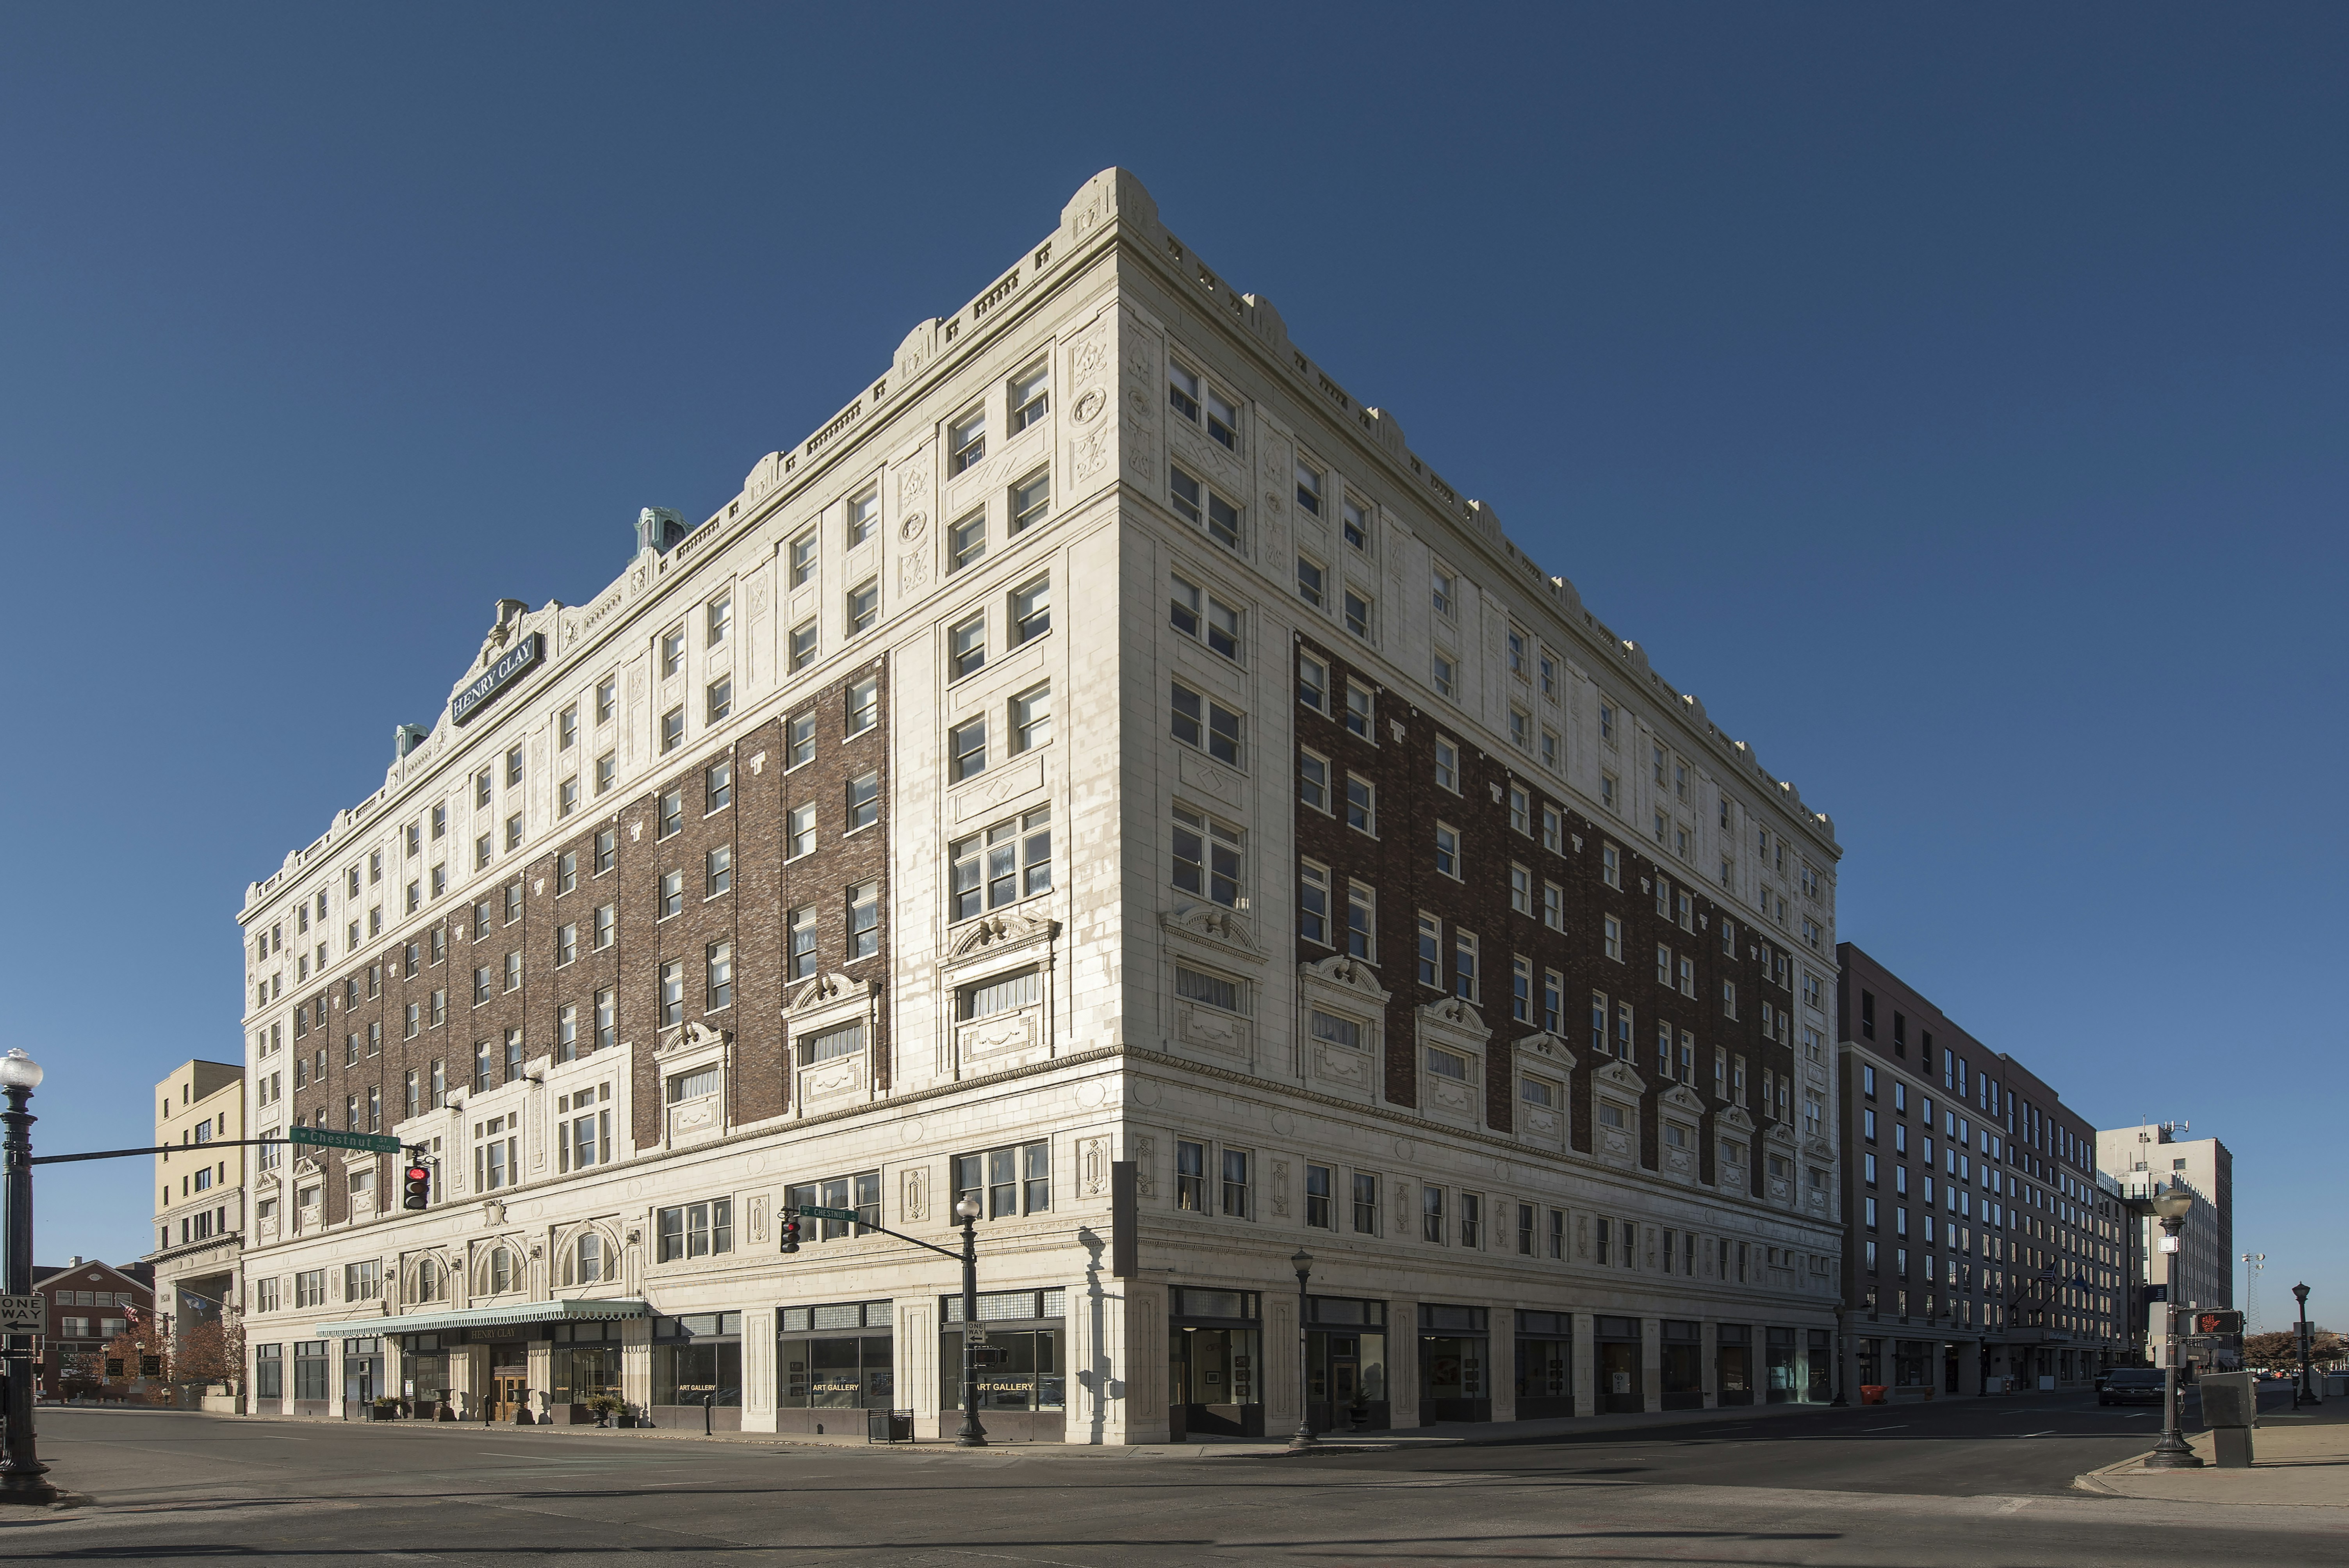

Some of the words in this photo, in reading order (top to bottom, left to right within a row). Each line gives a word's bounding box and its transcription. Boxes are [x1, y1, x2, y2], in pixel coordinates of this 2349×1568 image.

[453, 670, 496, 718] HENRY
[498, 640, 532, 678] CLAY
[310, 1132, 371, 1147] Chestnut
[814, 1208, 846, 1219] CHESTNUT
[2, 1298, 40, 1308] ONE
[2, 1309, 42, 1319] WAY
[471, 1329, 496, 1339] HENRY
[497, 1327, 516, 1337] CLAY
